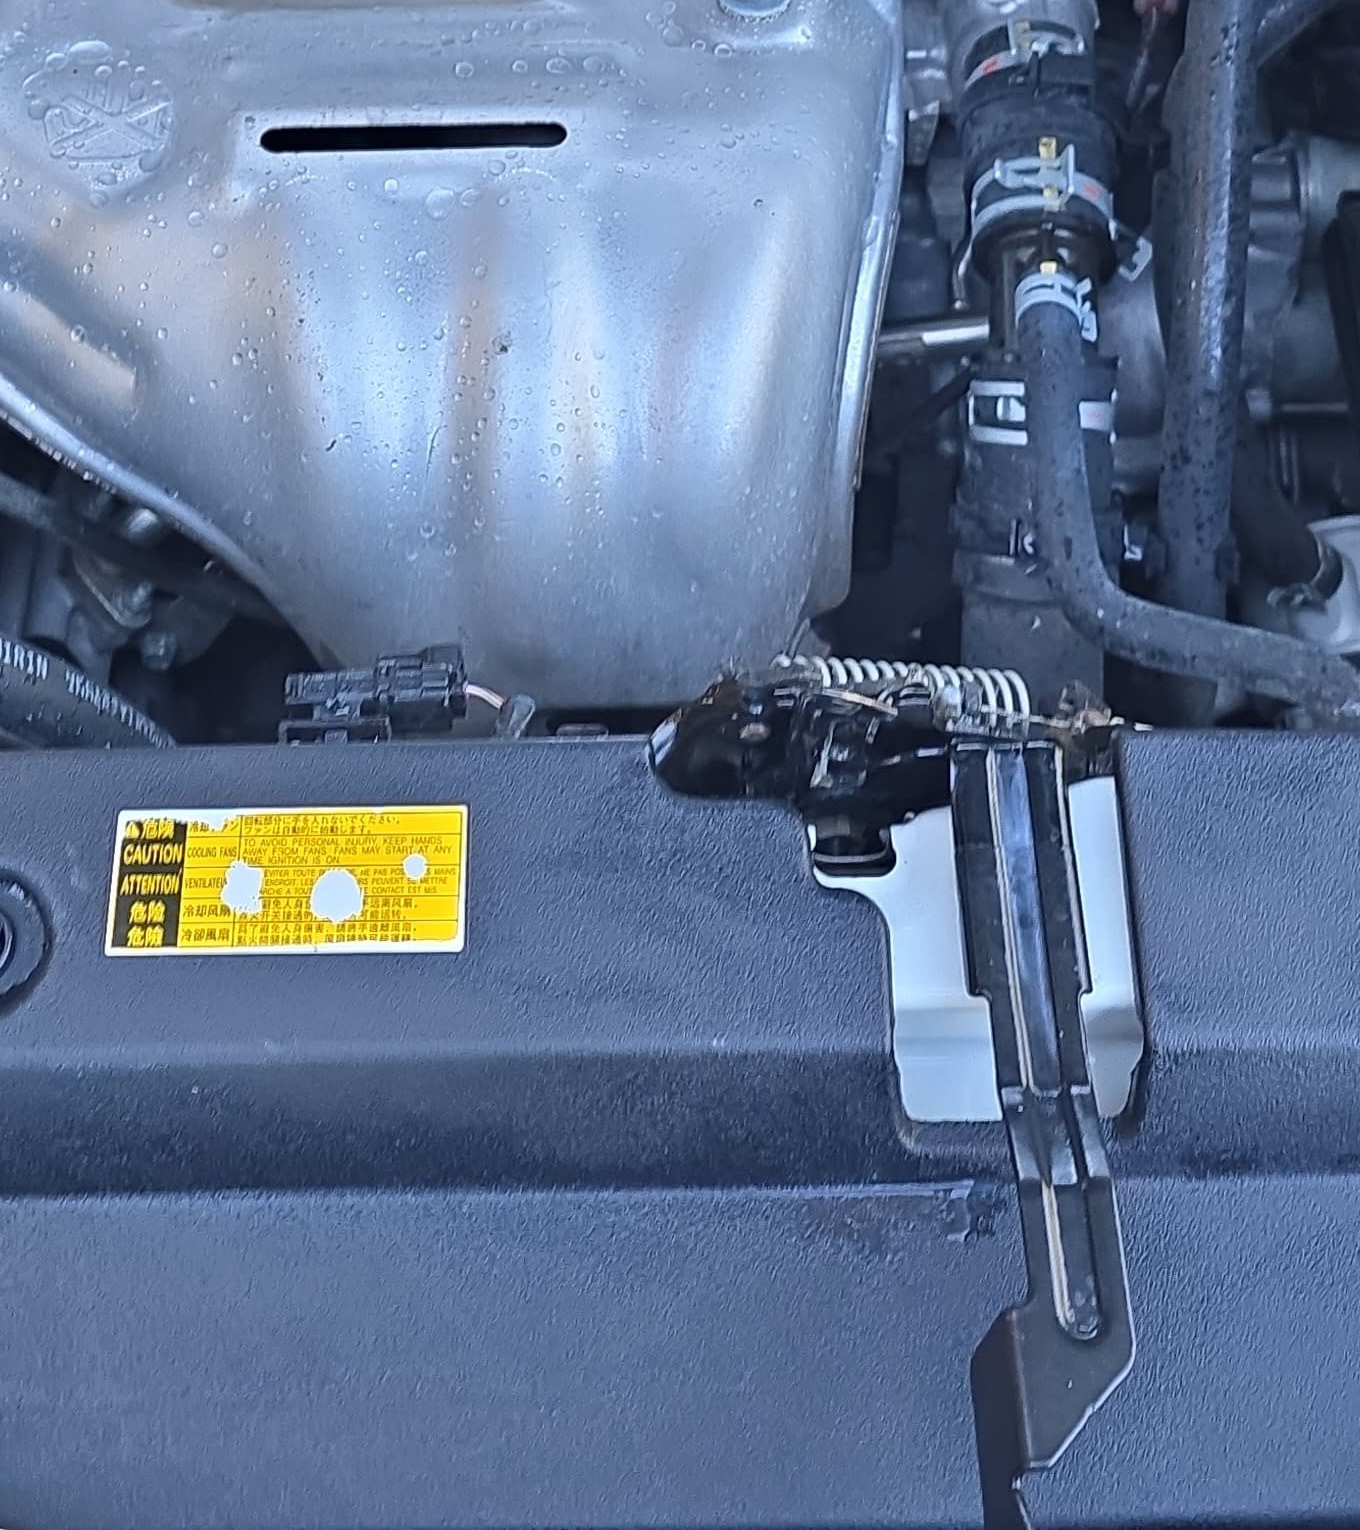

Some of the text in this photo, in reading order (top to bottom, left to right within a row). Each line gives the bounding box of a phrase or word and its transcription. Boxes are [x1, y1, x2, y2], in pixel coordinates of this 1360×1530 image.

[244, 838, 256, 847] TO
[260, 838, 287, 847] AVOID
[292, 837, 340, 847] PERSONAL
[383, 836, 407, 845] KEEP
[411, 836, 443, 845] HANDS
[123, 842, 184, 866] CAUTION
[187, 846, 237, 859] COOLING FANS
[242, 847, 273, 856] AWAY
[272, 847, 299, 856] FROM
[333, 846, 358, 856] FANS
[362, 846, 381, 855] MAY
[385, 846, 410, 855] START
[417, 846, 429, 855] AT
[433, 845, 453, 854] ANY
[243, 856, 264, 865] TIME
[268, 856, 309, 865] IGNITION
[312, 856, 321, 865] IS
[264, 869, 290, 878] EVITER
[292, 869, 316, 878] TOUTE
[360, 869, 370, 877] NE
[373, 869, 388, 877] PAS
[434, 868, 457, 876] MAINS
[120, 872, 182, 896] ATTENTION
[371, 877, 404, 885] PEUVENT
[371, 886, 405, 895] CONTACT
[407, 886, 422, 894] EST
